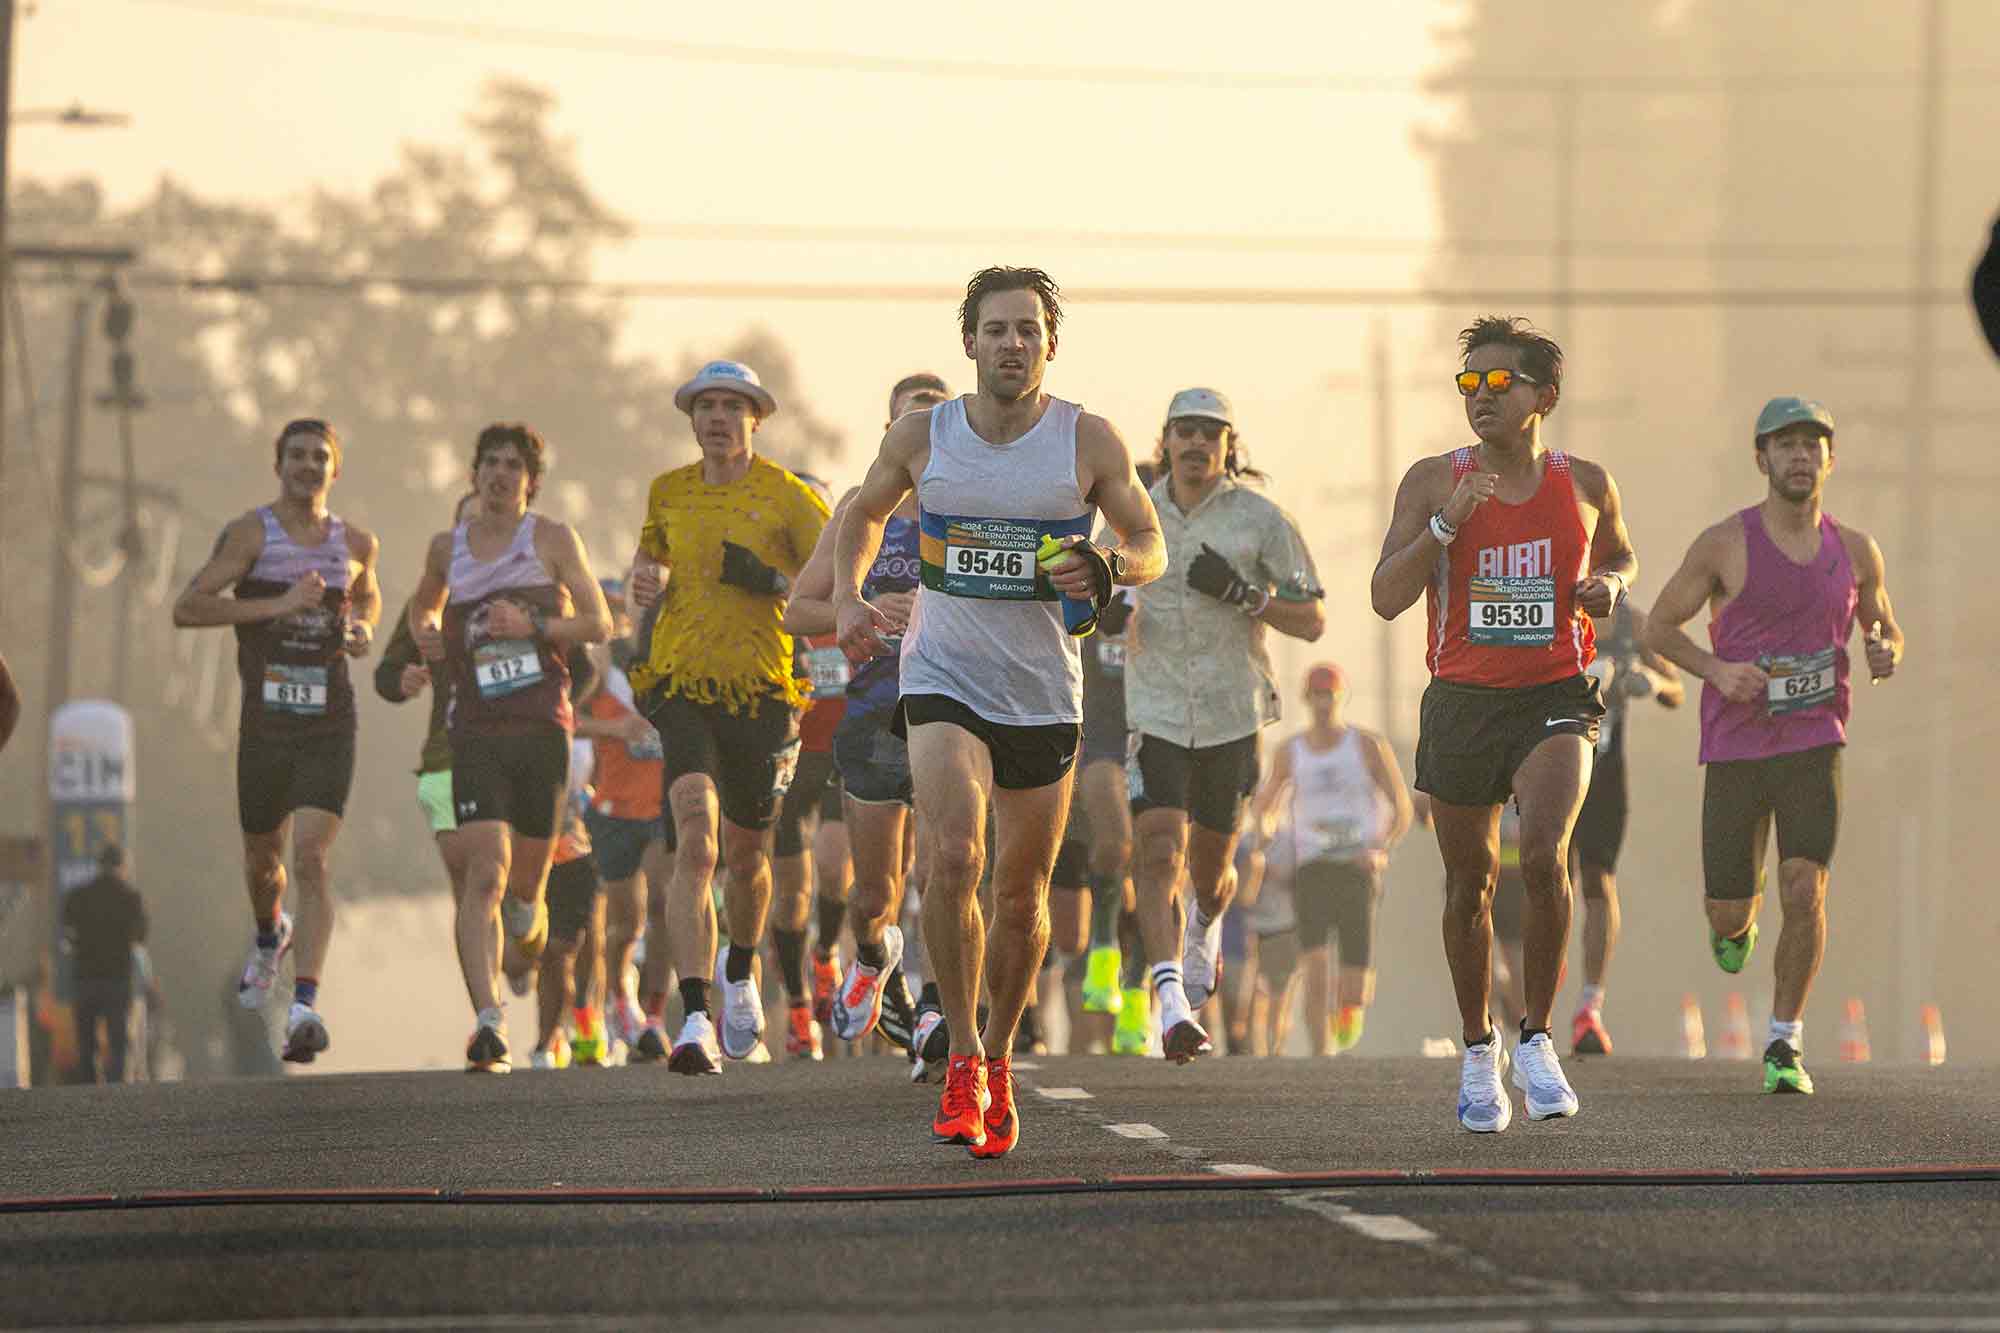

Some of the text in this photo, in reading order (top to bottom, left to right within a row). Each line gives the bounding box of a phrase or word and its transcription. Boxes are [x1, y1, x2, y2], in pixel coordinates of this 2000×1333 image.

[988, 524, 1037, 534] CALIFORNIA
[973, 531, 1036, 541] INTERNATIONAL
[989, 540, 1036, 549] MARATHON
[957, 549, 1023, 577] 9546
[1510, 577, 1554, 586] CALIFORNIA
[989, 583, 1035, 593] MARATHON
[1495, 585, 1553, 593] INTERNATIONAL
[1481, 604, 1544, 626] 9530
[1512, 633, 1554, 641] MARATHON
[490, 655, 523, 681] 612
[1785, 672, 1821, 697] 623
[277, 686, 312, 704] 613
